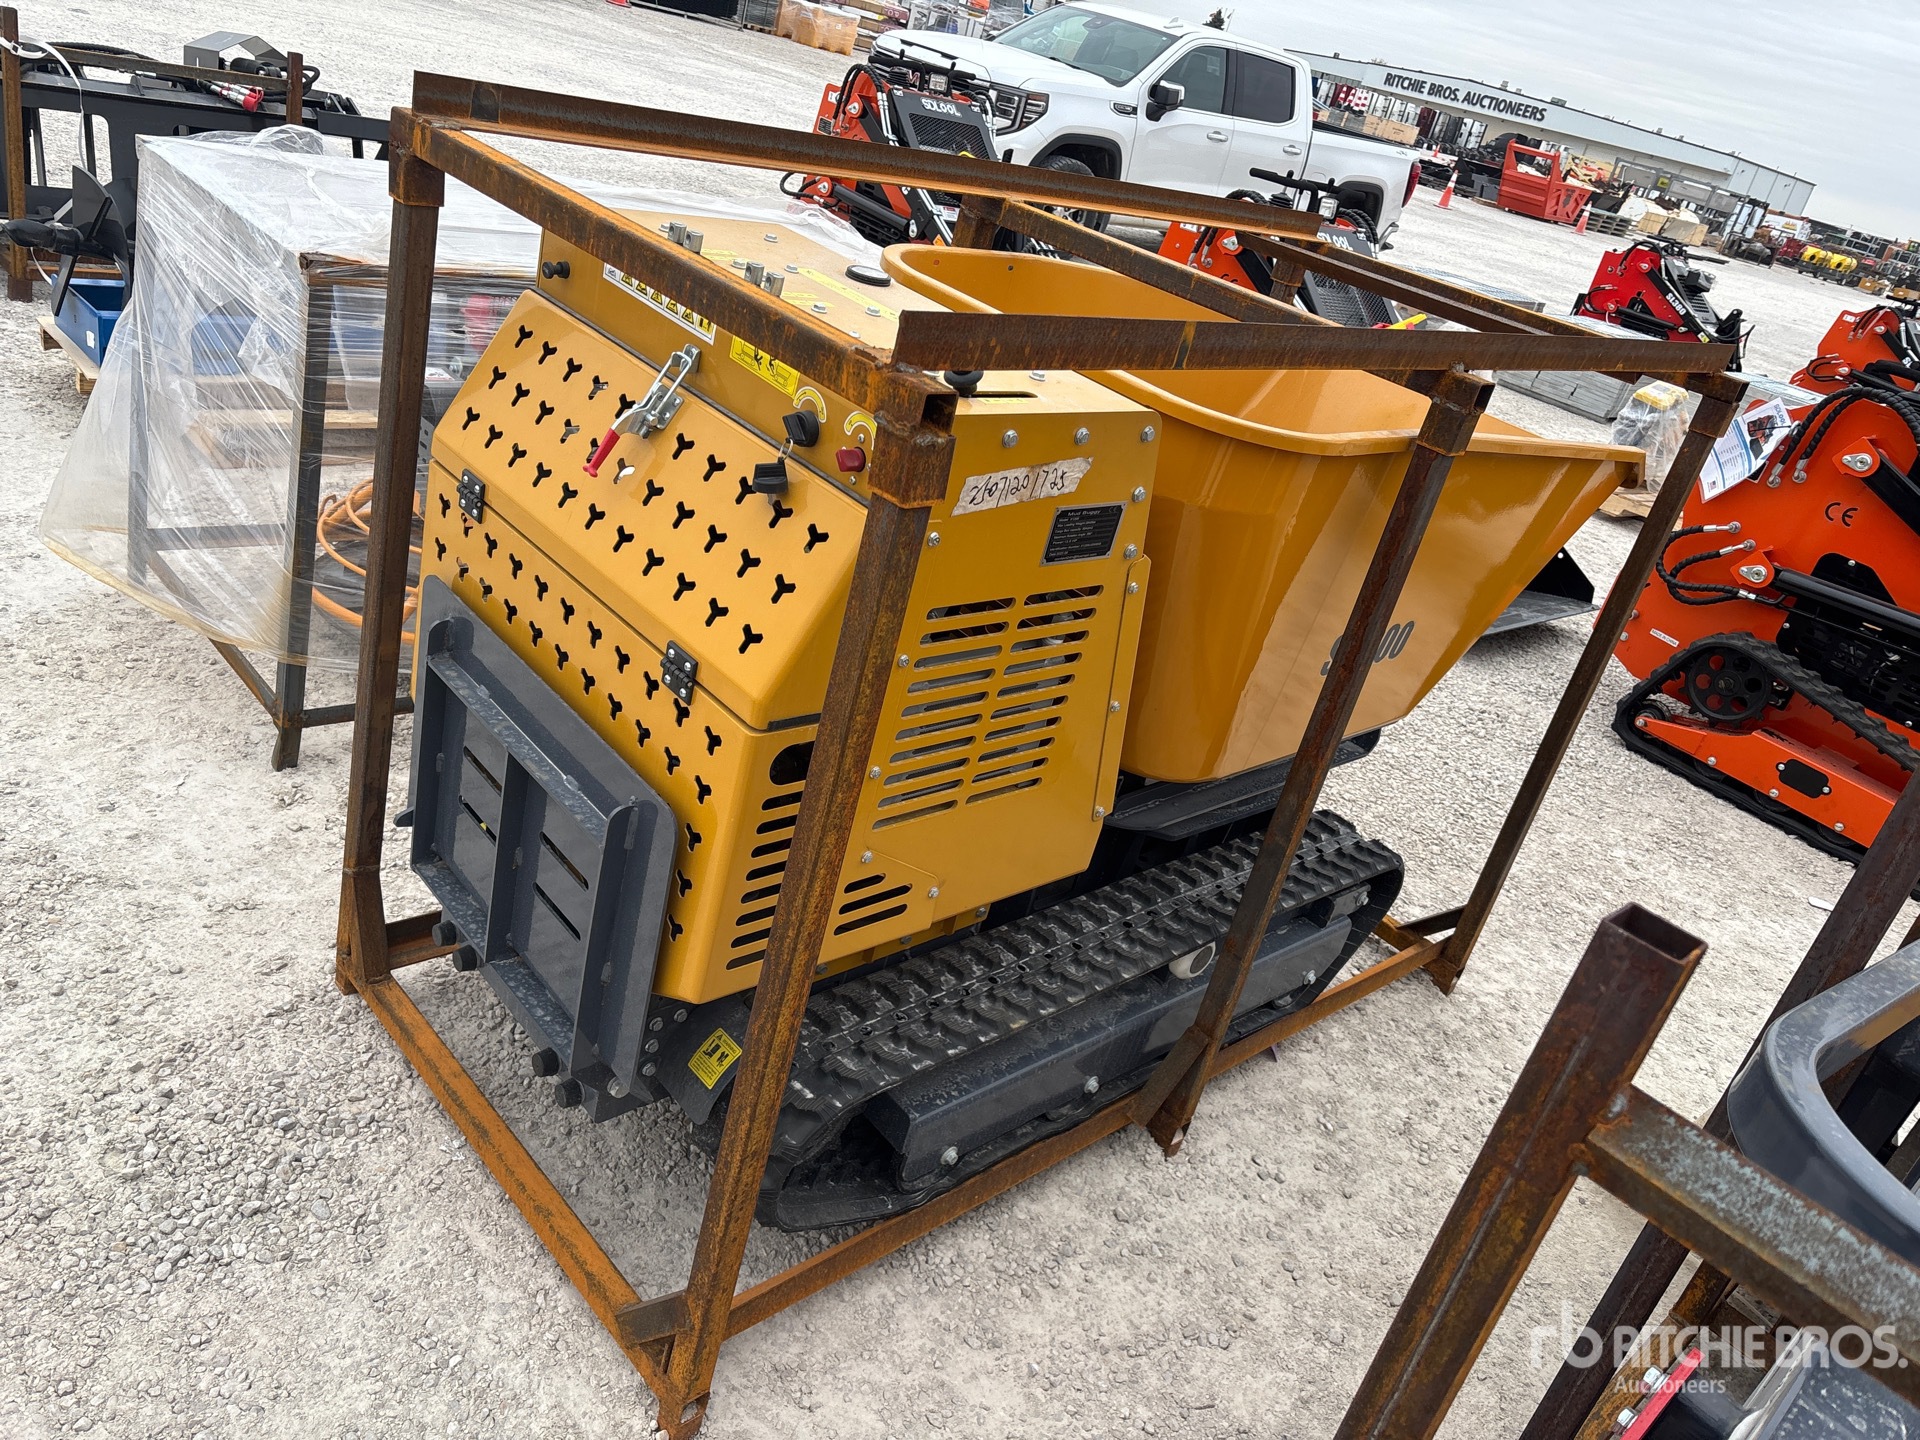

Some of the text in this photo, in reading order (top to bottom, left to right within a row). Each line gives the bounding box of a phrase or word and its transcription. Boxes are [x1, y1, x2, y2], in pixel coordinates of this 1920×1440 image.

[1384, 73, 1547, 122] RITCHIE BROS. AUCTIONEERS
[1825, 502, 1858, 527] CE
